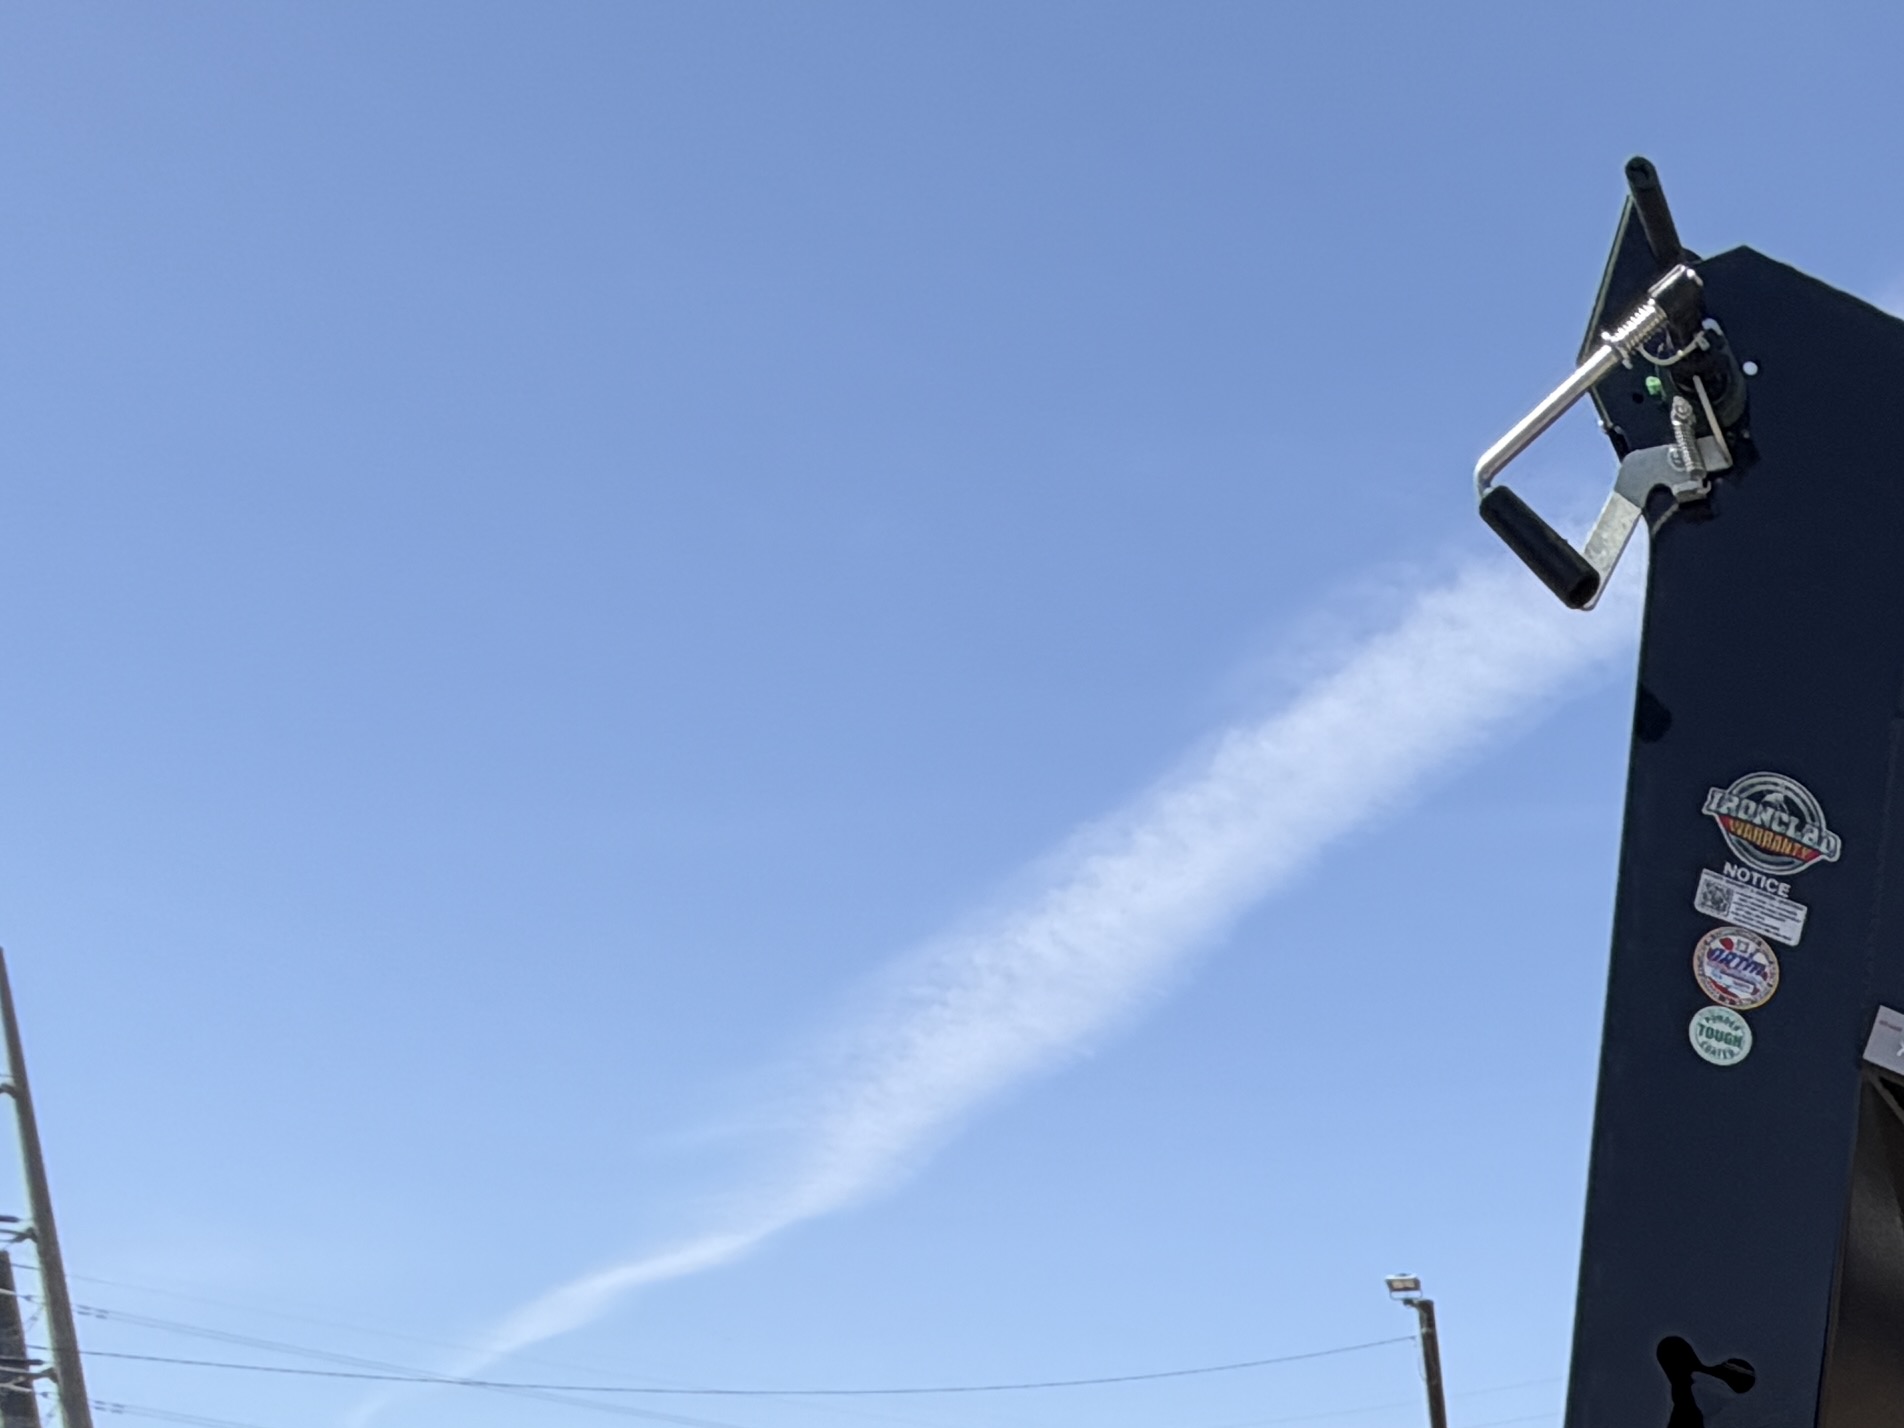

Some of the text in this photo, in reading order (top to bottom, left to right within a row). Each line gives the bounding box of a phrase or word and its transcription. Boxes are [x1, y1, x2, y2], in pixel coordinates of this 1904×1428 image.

[1709, 792, 1837, 857] IRONCLAD
[1723, 861, 1791, 898] NOTICE
[1697, 1022, 1744, 1048] TOUGH
